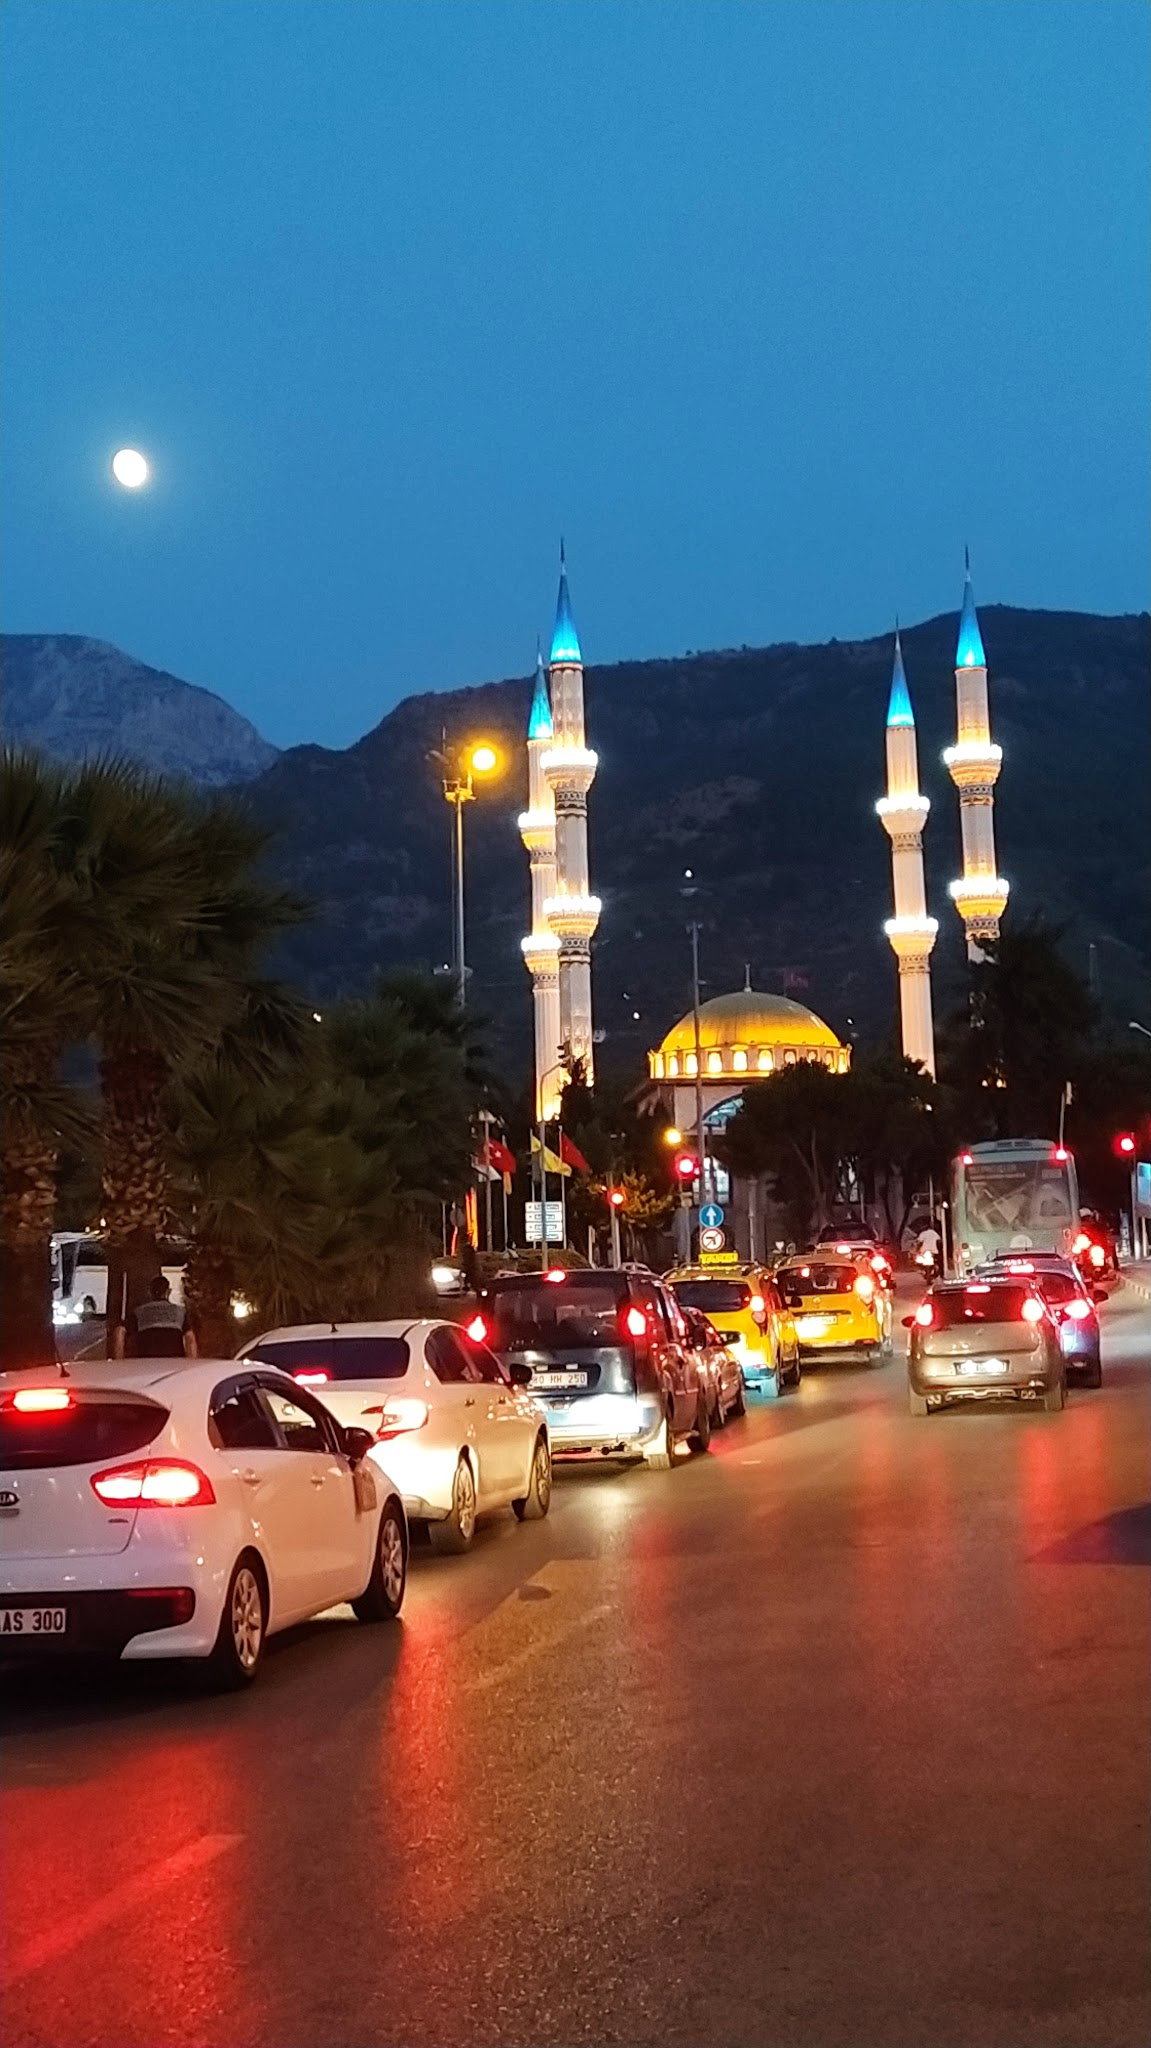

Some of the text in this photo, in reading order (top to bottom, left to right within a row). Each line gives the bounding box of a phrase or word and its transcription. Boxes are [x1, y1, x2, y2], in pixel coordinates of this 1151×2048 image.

[568, 1373, 586, 1384] 250
[0, 1610, 63, 1632] AS 300
